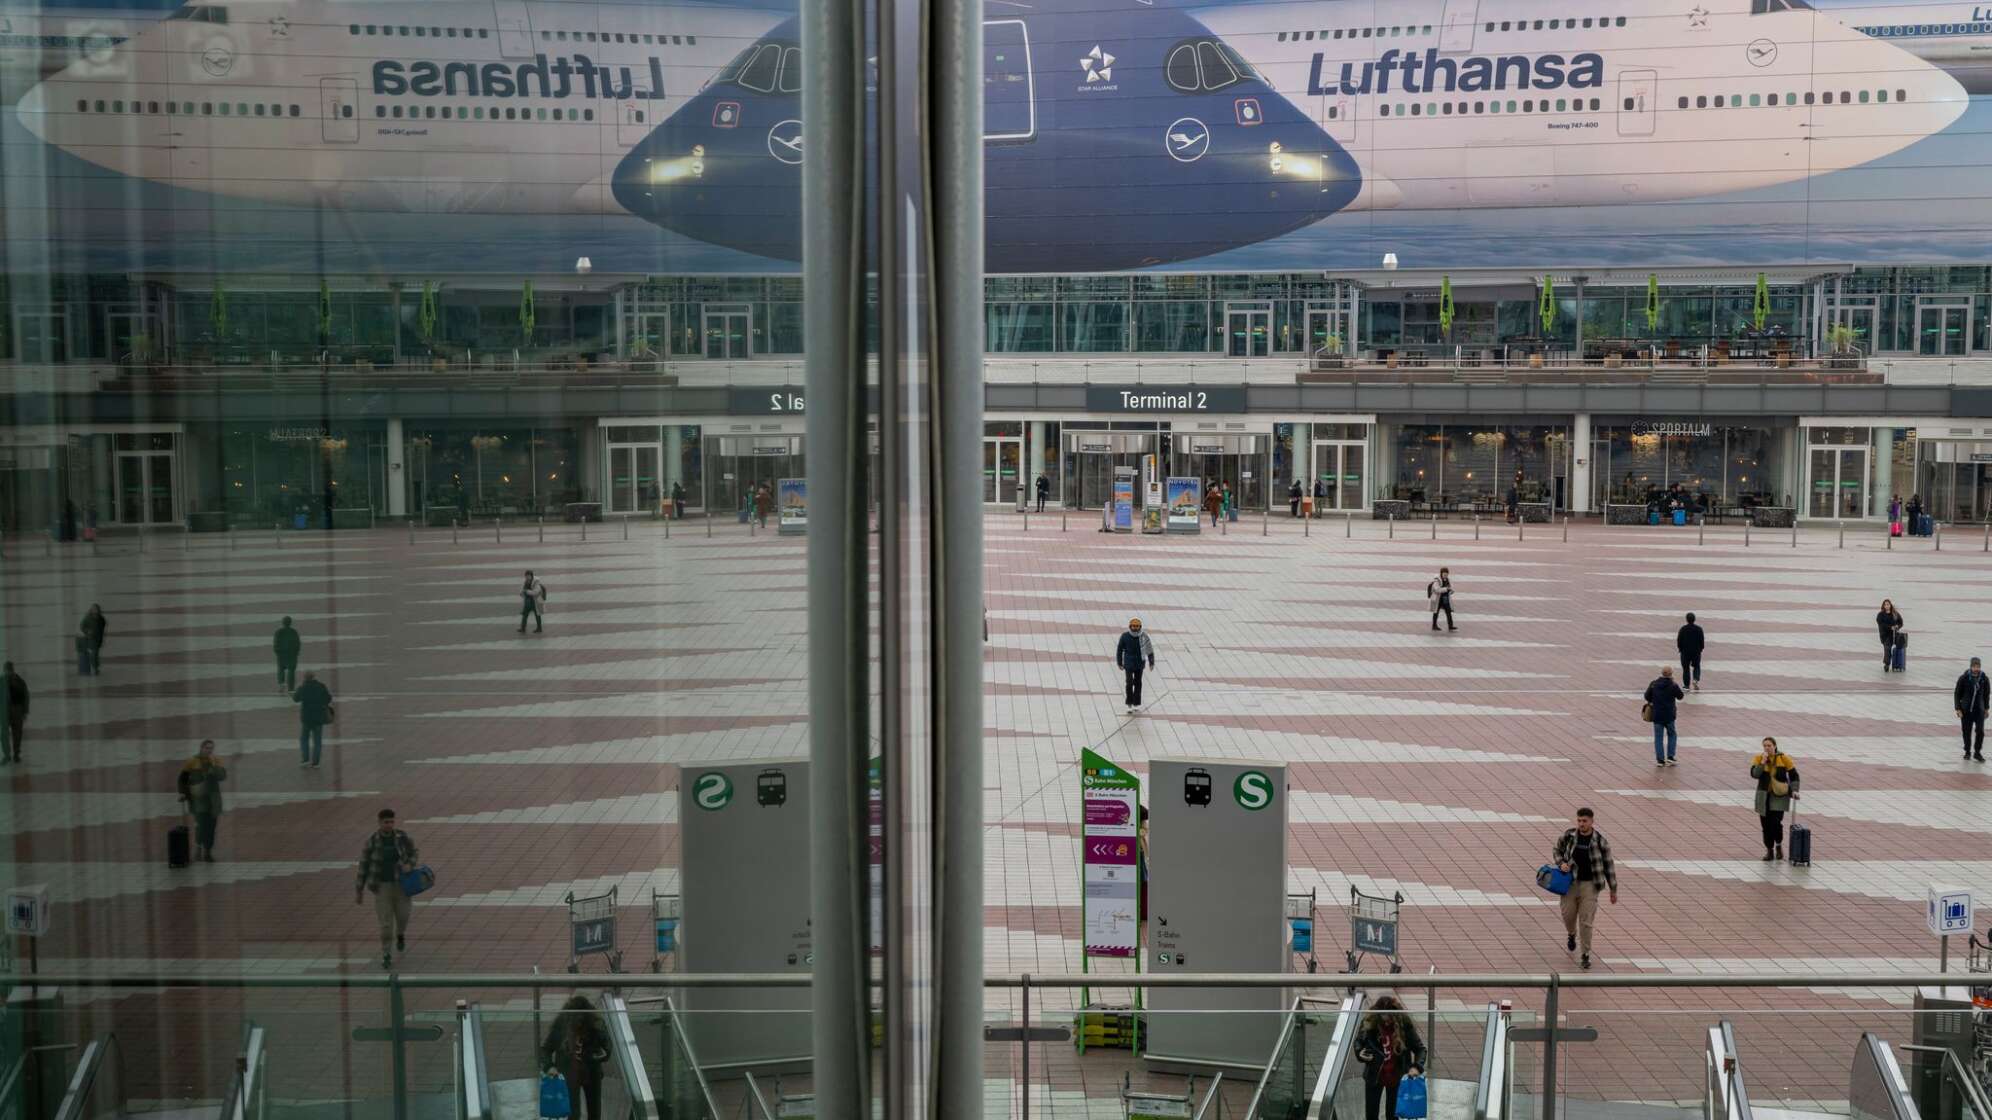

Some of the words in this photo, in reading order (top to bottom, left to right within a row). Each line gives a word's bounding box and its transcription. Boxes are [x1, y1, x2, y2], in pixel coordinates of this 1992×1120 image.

[1307, 48, 1604, 96] Lufthansa
[1548, 122, 1570, 130] Boeing
[1571, 121, 1599, 129] 747-400
[1120, 391, 1192, 409] Terminal
[1197, 392, 1207, 409] 2
[1652, 422, 1711, 437] SPORTALM
[1239, 773, 1268, 808] S
